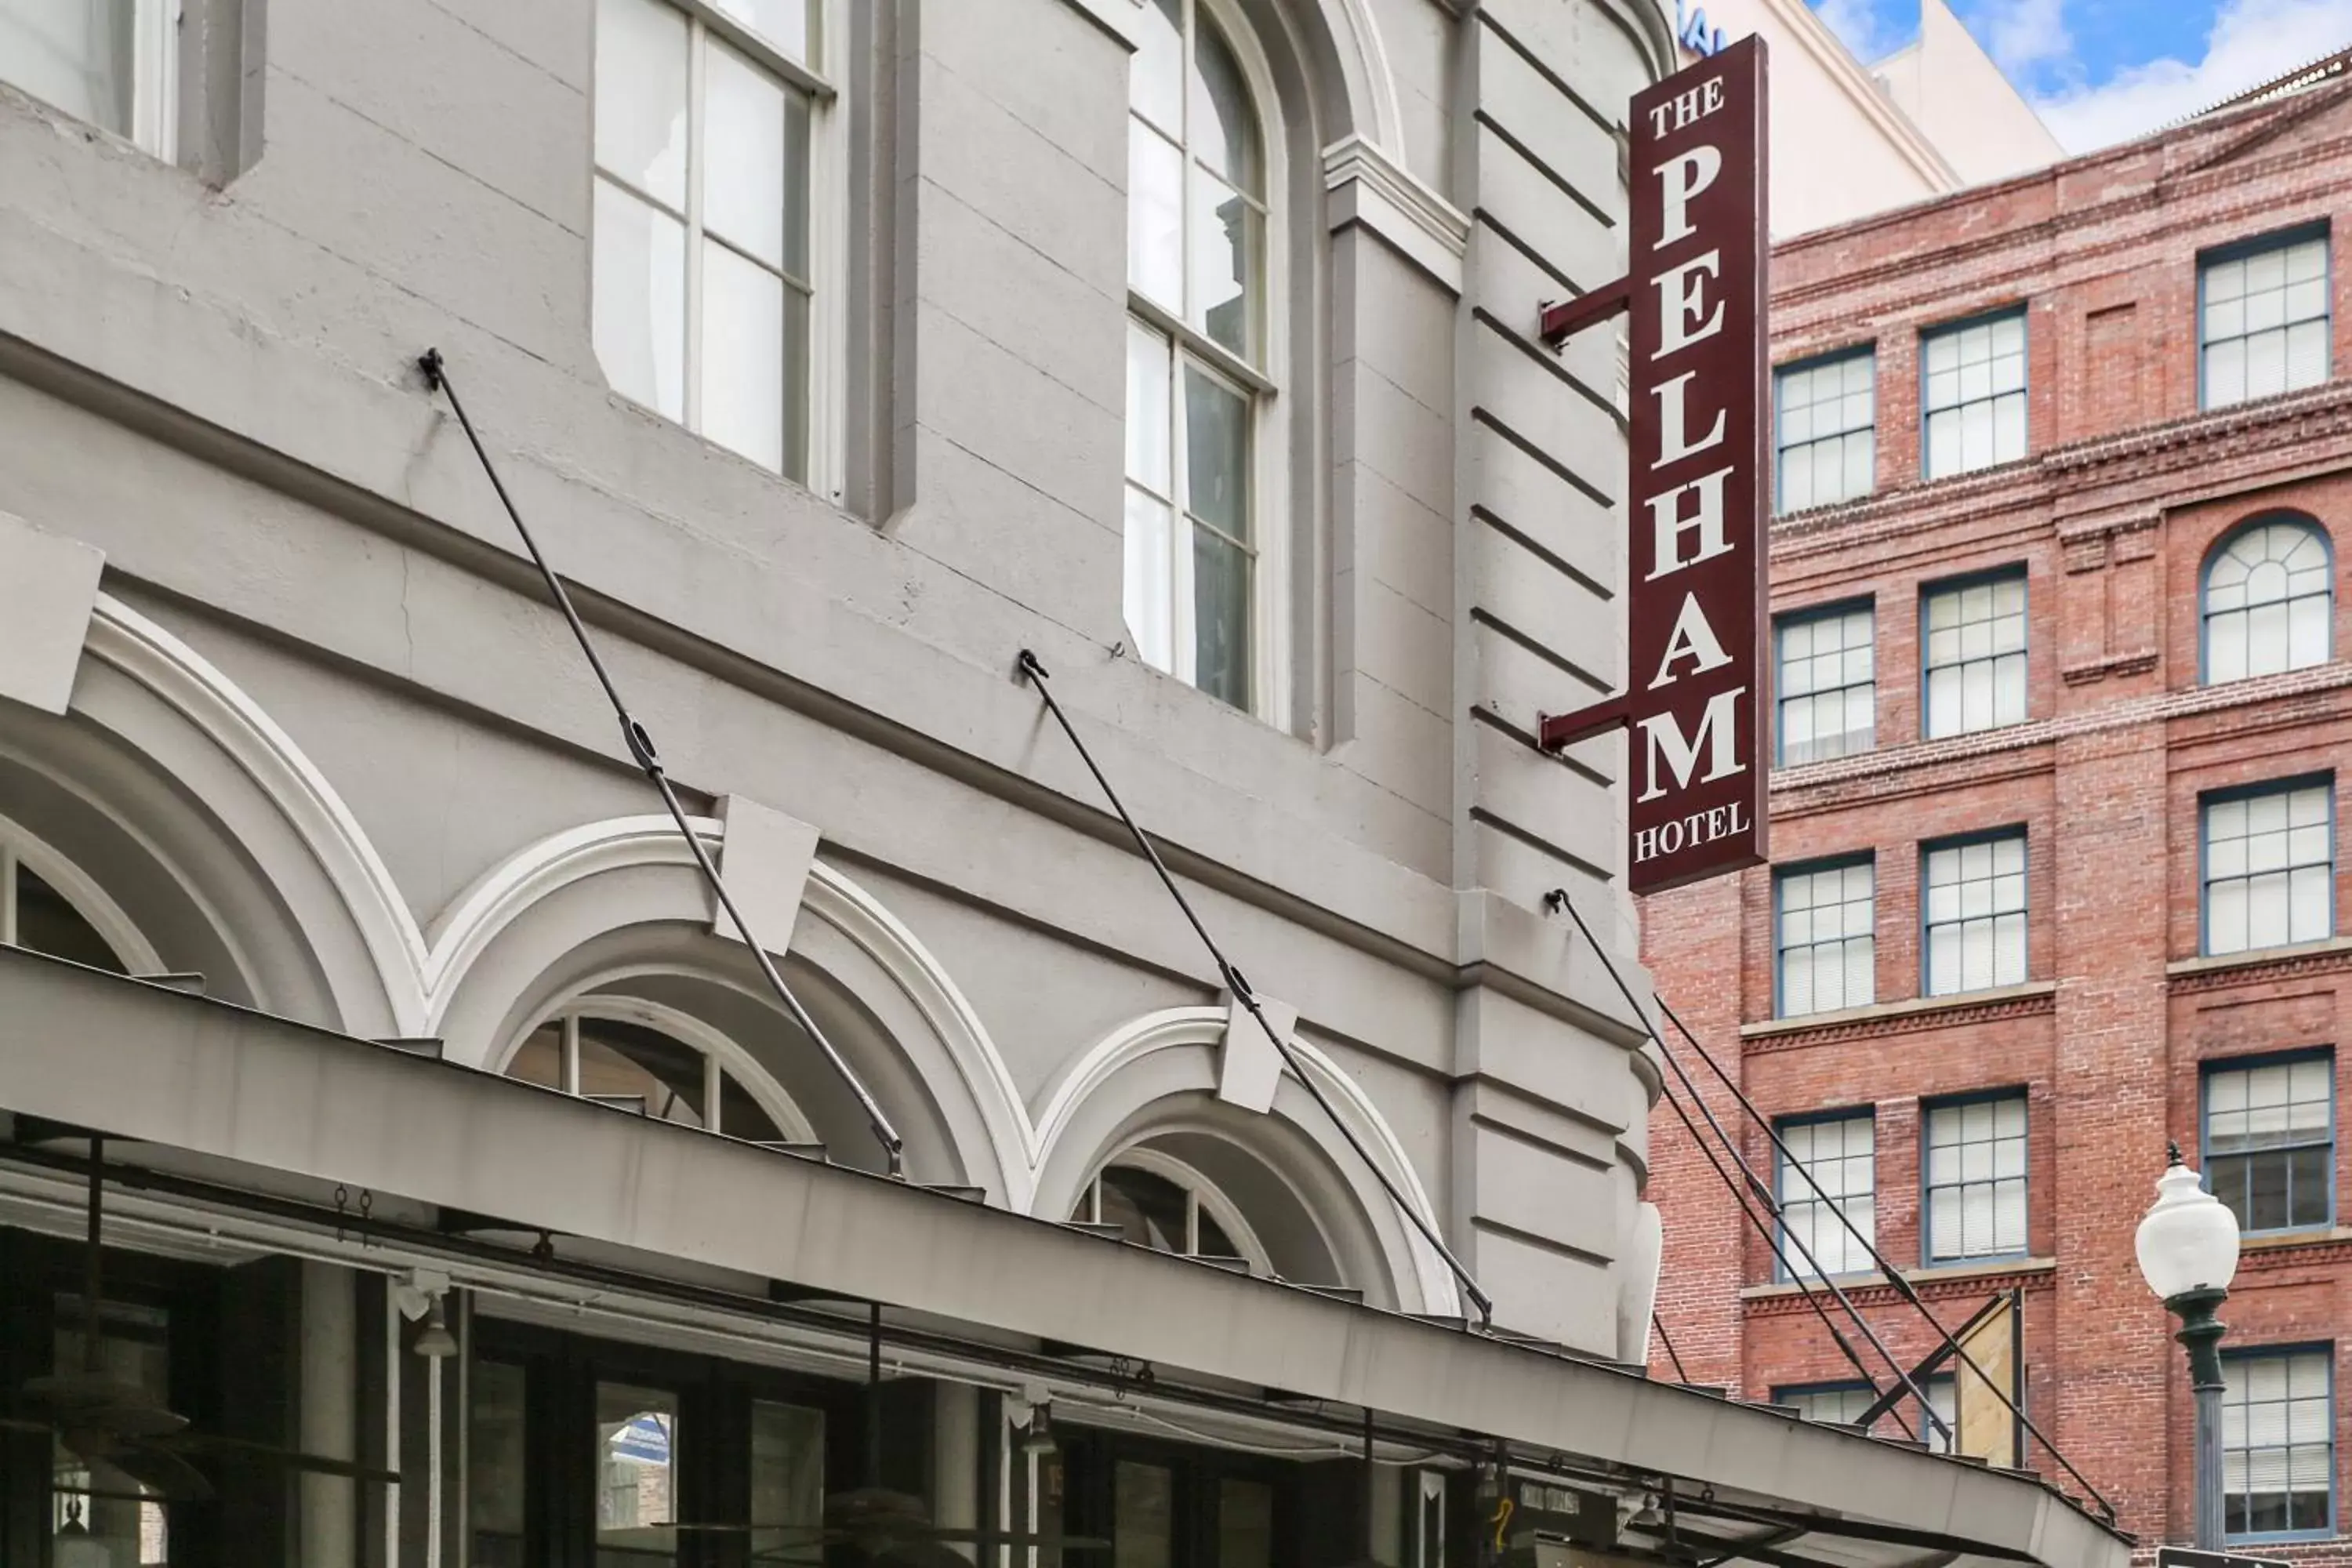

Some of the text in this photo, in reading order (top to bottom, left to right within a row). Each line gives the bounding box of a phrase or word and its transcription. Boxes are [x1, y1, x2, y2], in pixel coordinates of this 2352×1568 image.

[1650, 76, 1725, 140] THE
[1636, 145, 1747, 803] PELHAM
[1635, 800, 1750, 862] HOTEL
